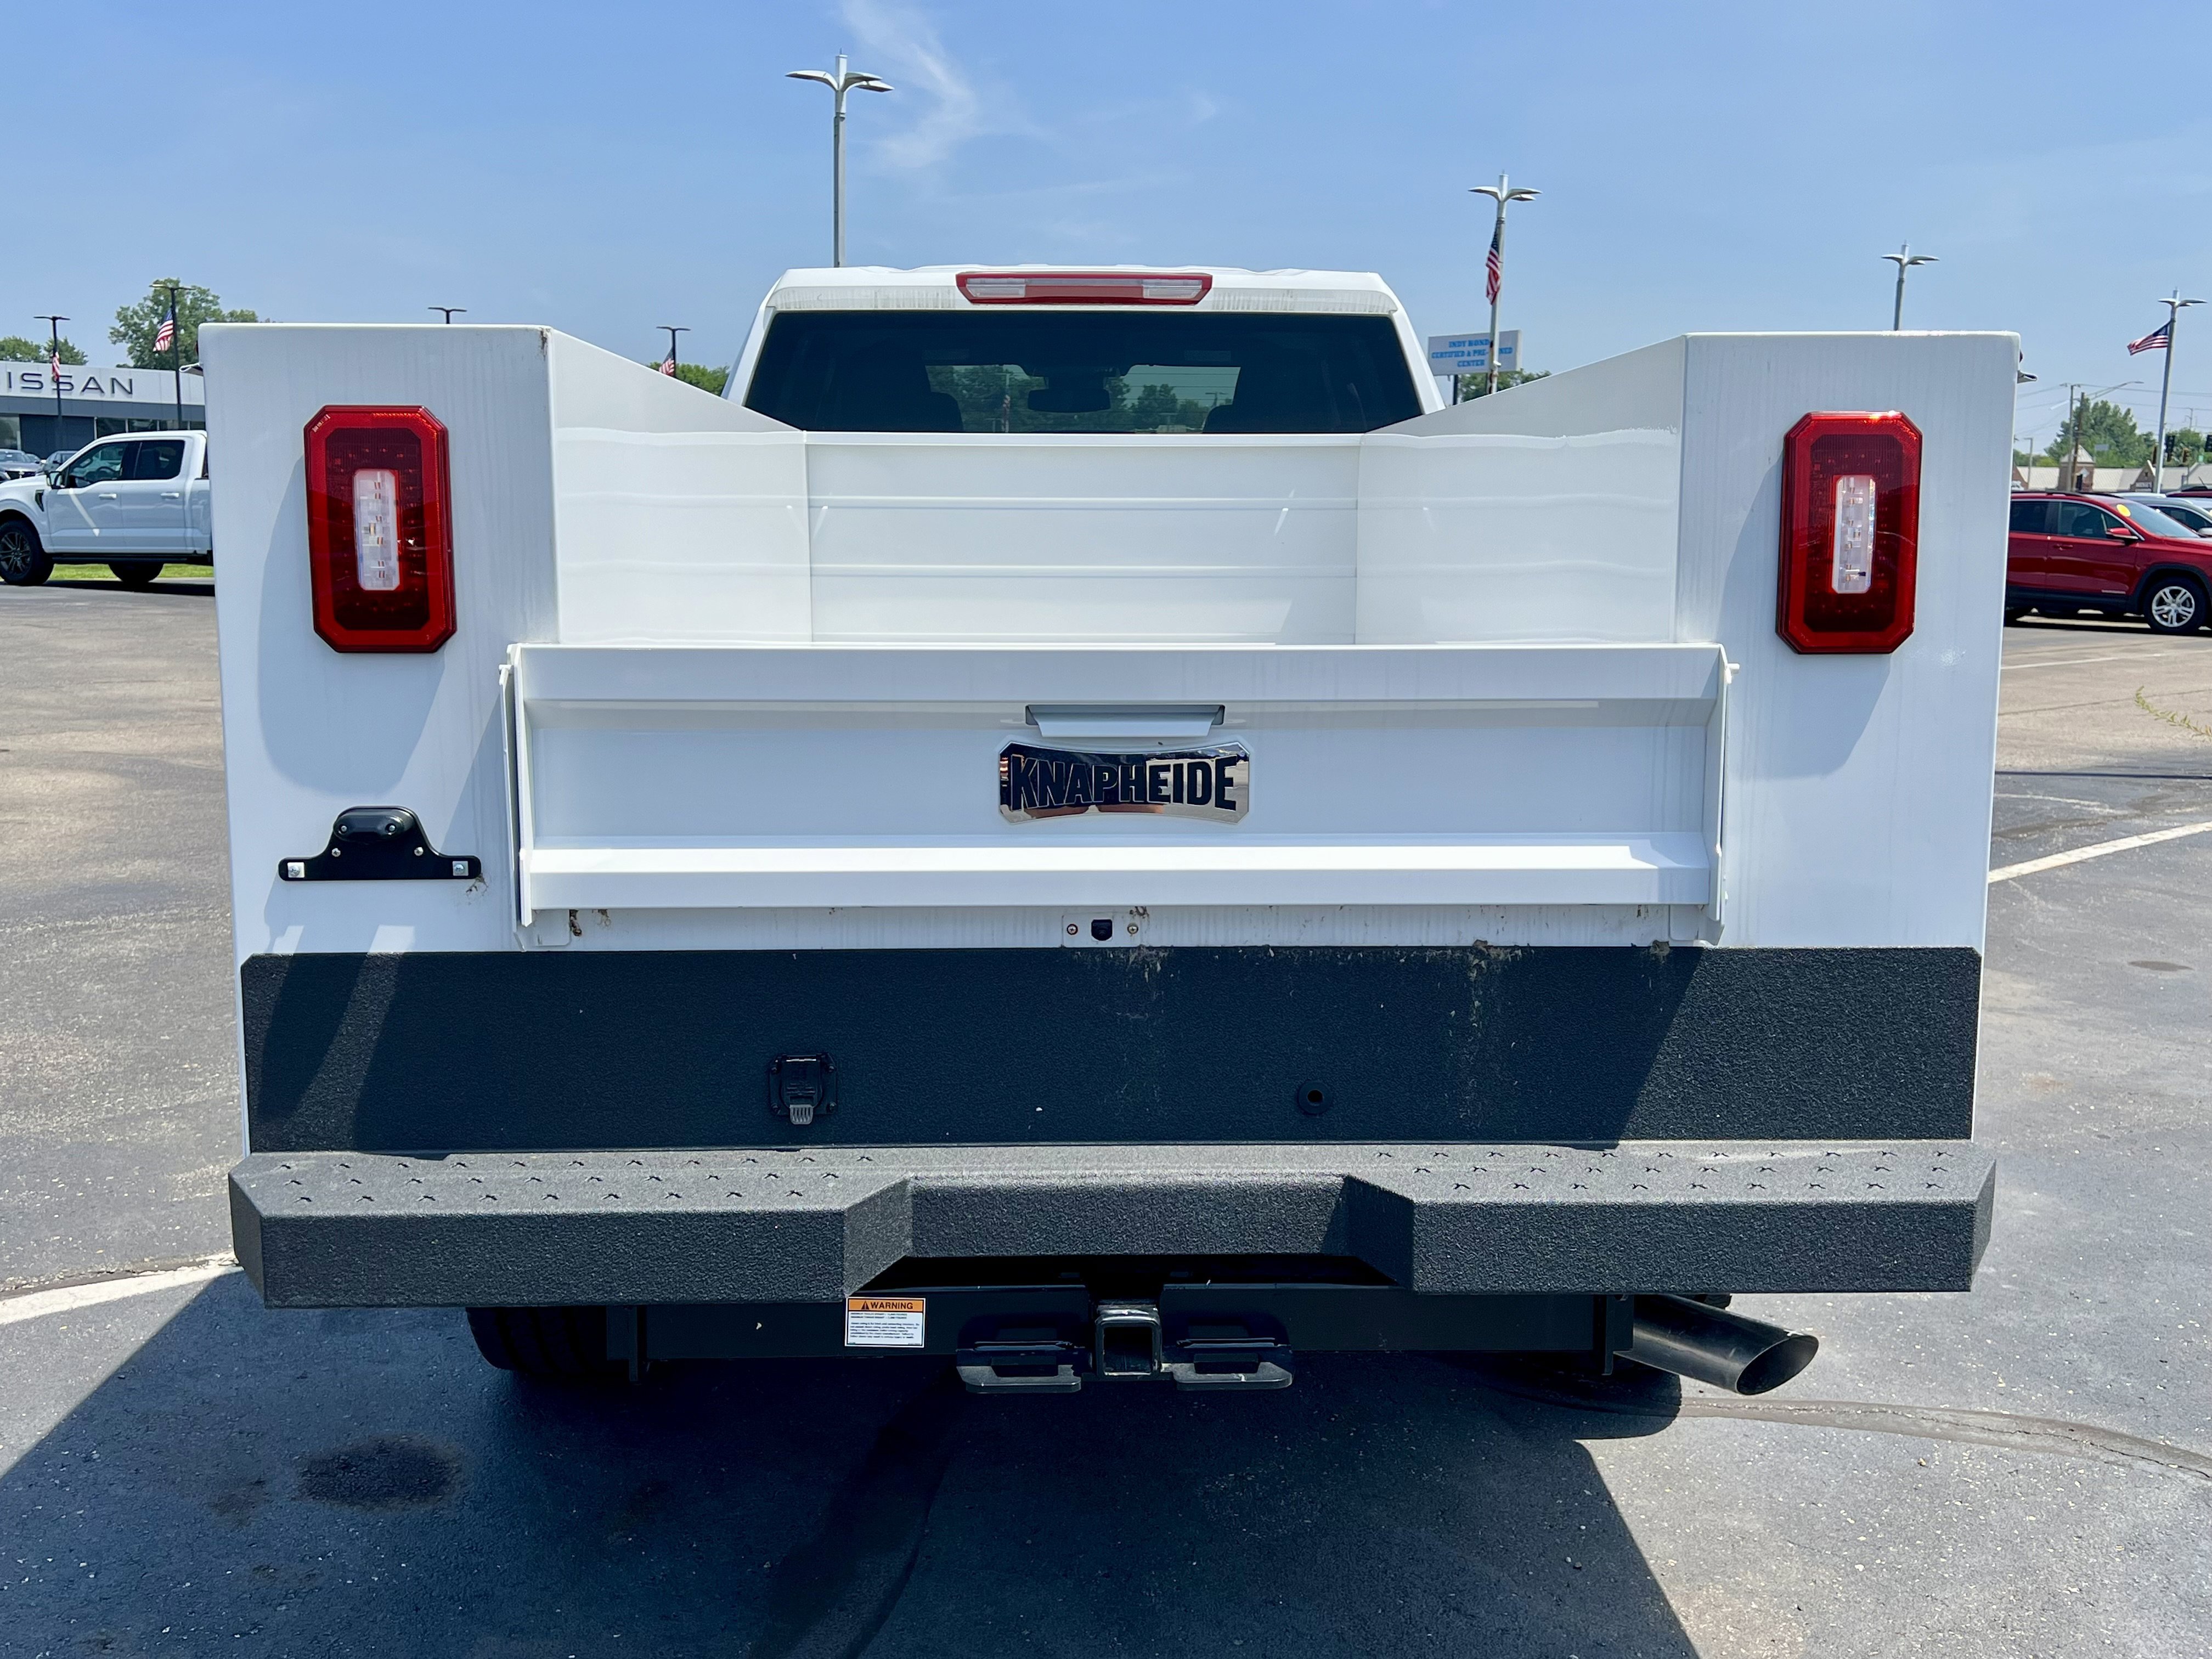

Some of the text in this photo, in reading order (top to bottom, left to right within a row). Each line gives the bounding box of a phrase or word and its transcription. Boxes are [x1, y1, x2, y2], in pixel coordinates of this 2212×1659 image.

[1468, 338, 1489, 347] HOND
[7, 371, 133, 394] ISSAN
[1011, 754, 1238, 811] KNAPHEIDE
